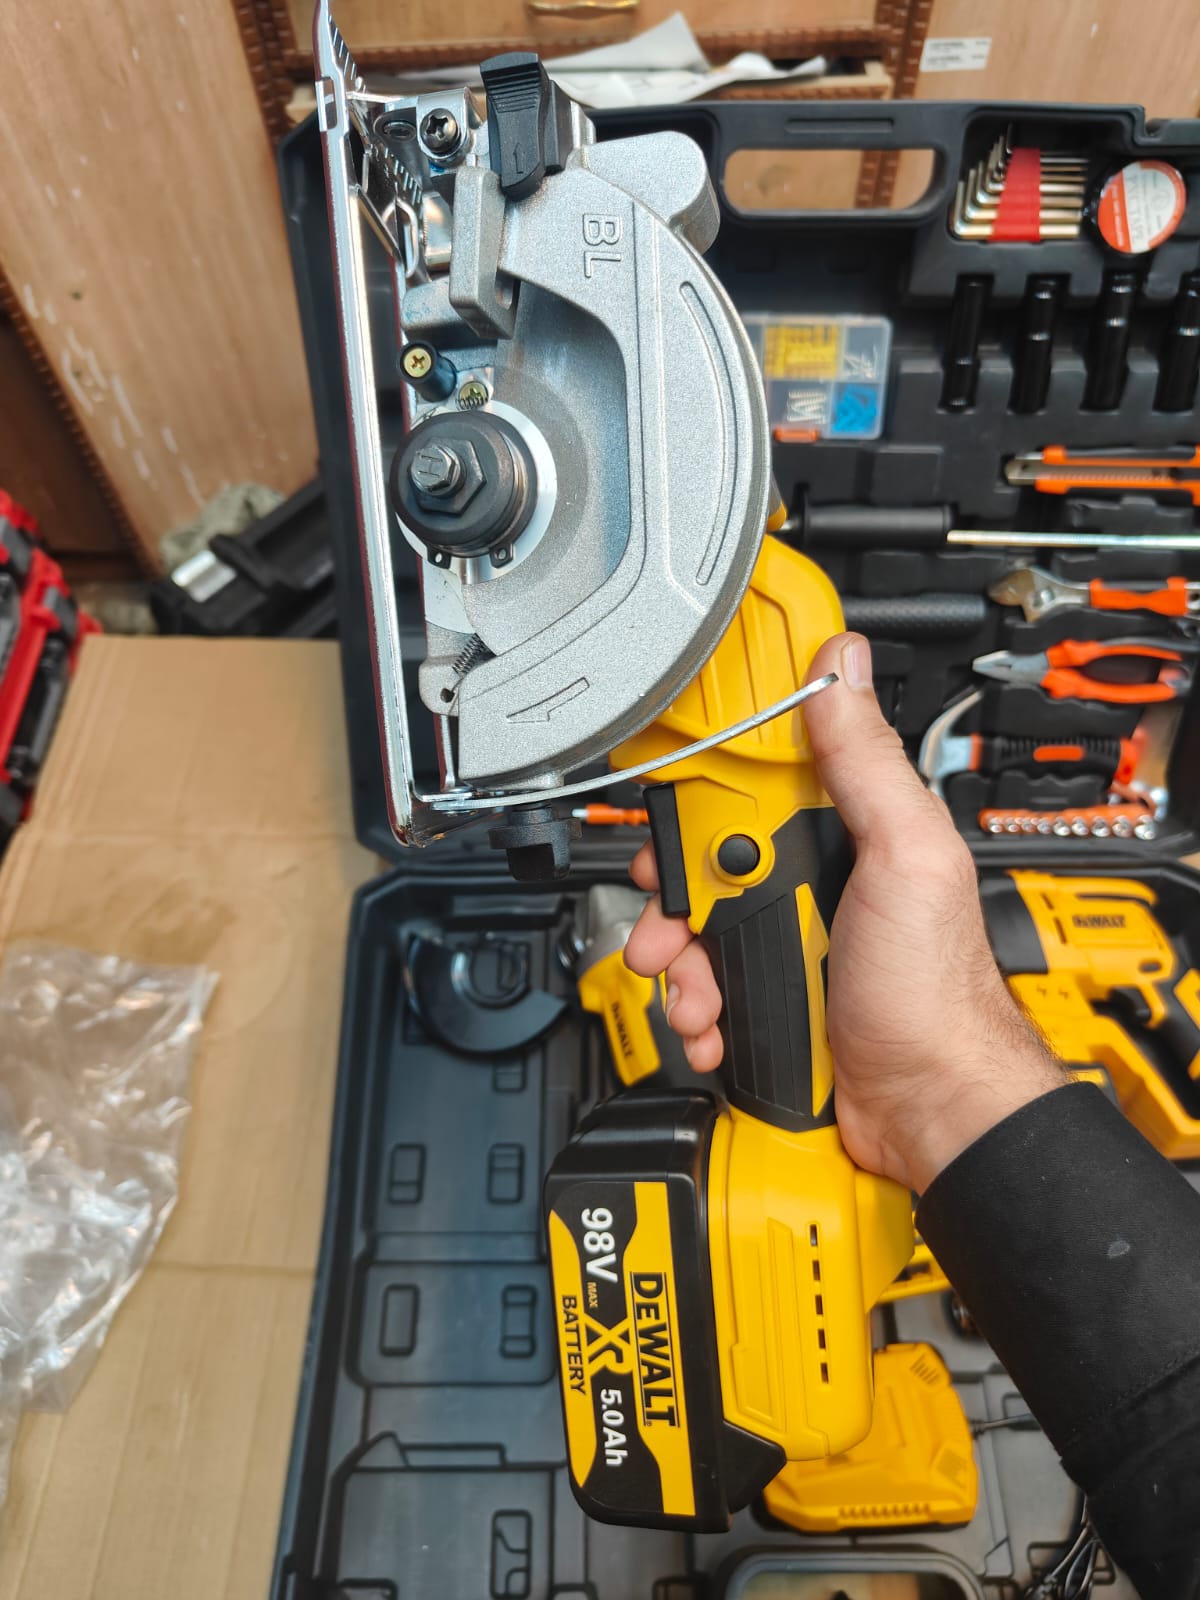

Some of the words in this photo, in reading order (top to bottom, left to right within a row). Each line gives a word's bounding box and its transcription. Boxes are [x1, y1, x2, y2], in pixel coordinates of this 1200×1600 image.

[583, 212, 622, 279] BL
[581, 1207, 619, 1283] 98V
[586, 1281, 599, 1308] MAX
[562, 1294, 587, 1396] BATTERY
[600, 1388, 629, 1467] 5.0Ah
